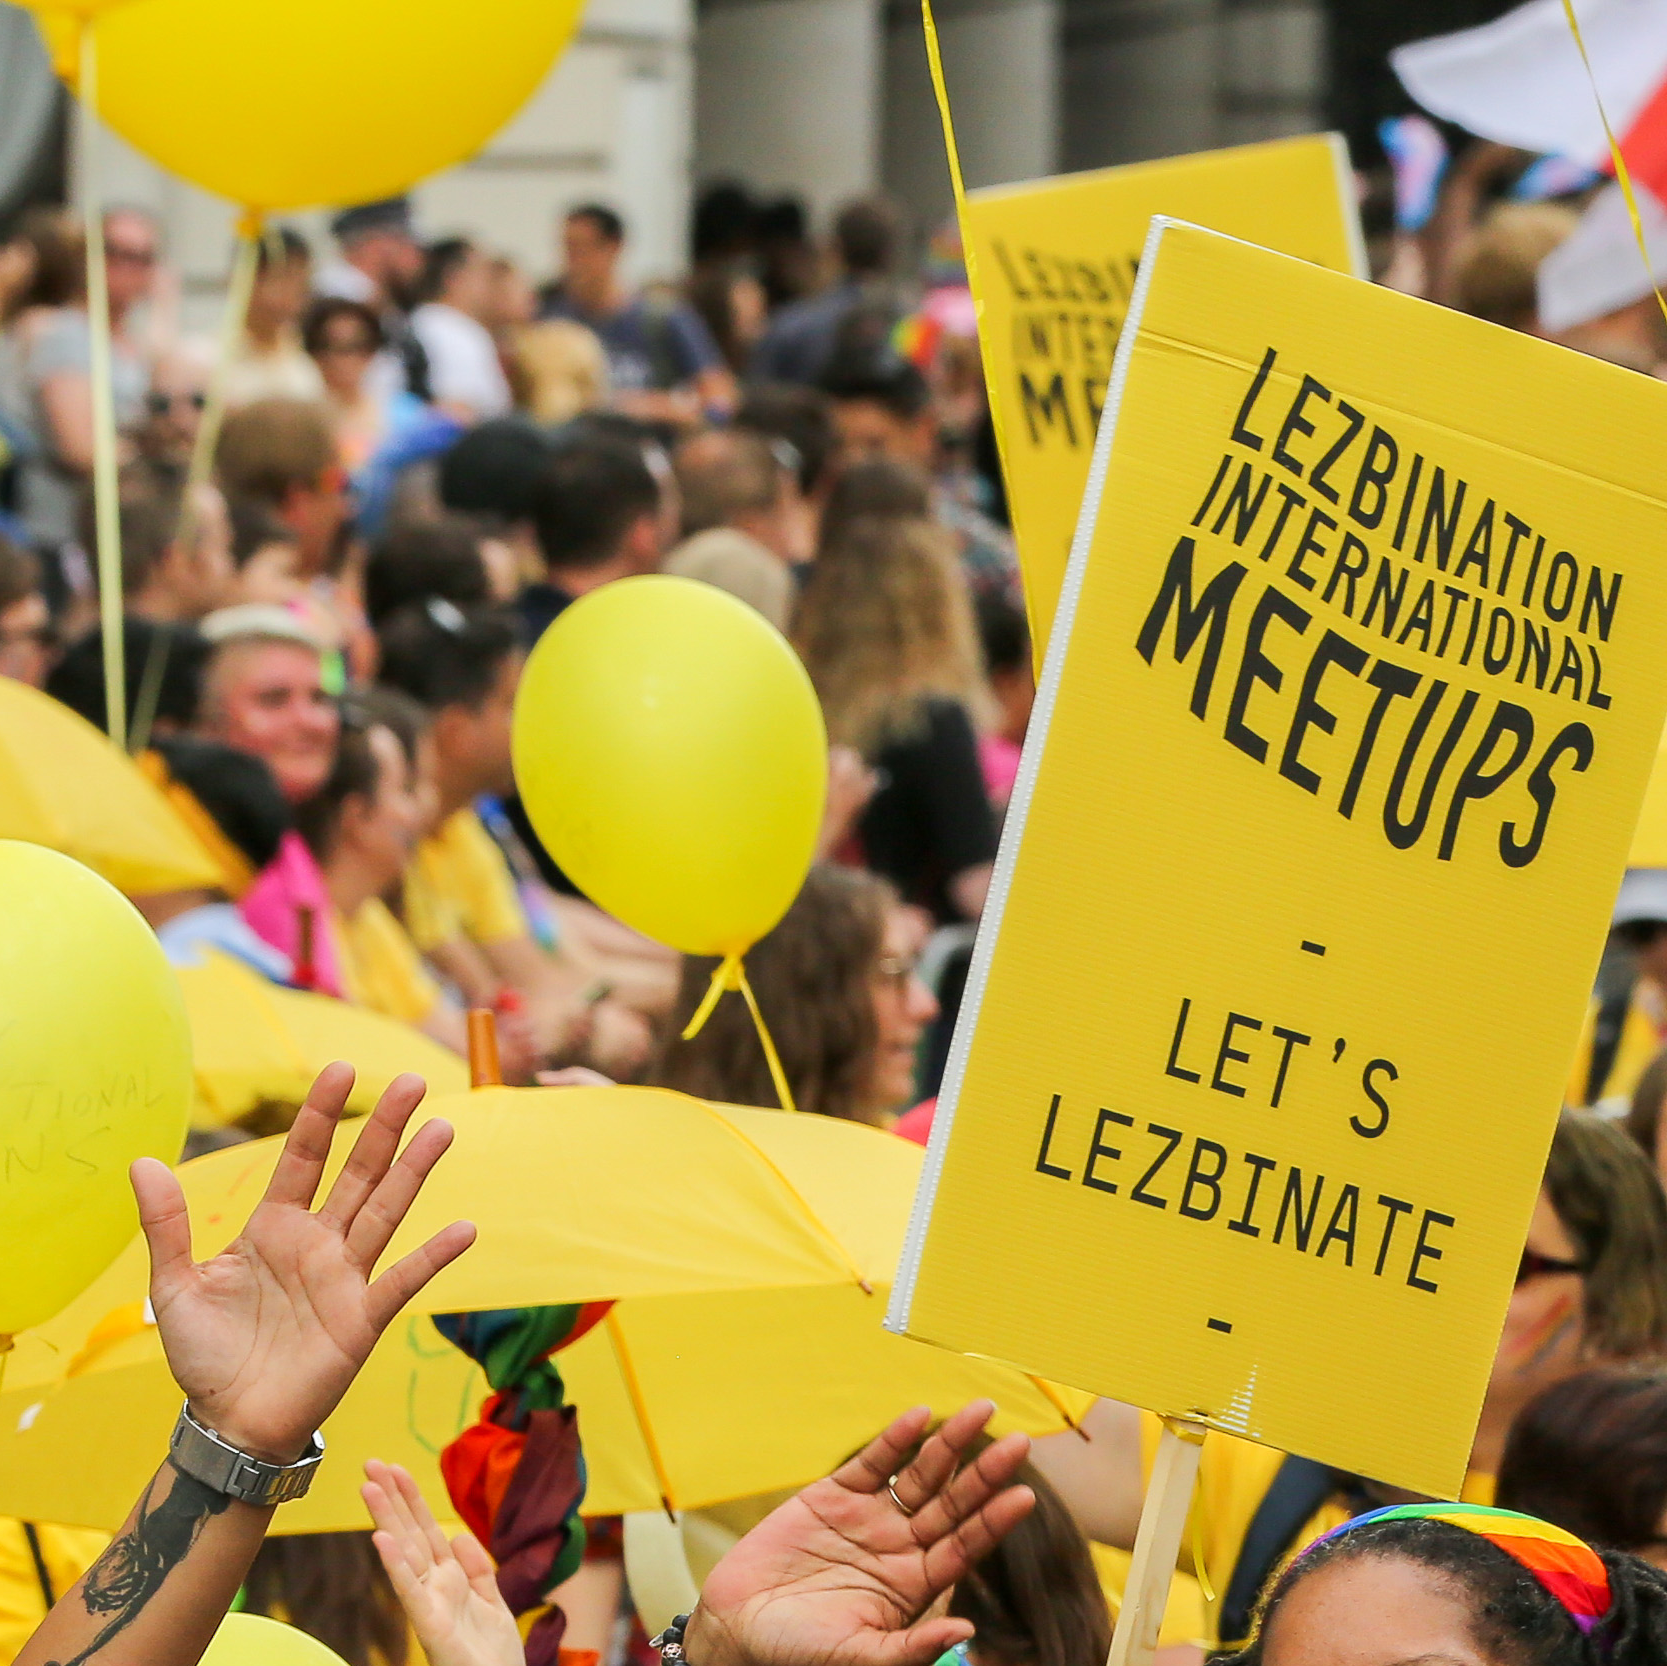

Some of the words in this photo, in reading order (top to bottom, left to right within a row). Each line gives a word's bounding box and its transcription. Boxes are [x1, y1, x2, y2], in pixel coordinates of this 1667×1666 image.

[1191, 454, 1612, 710] INTERNATIONAL
[1230, 347, 1622, 642] LEZBINATION
[1134, 536, 1594, 868] MEETUPS
[1034, 1093, 1455, 1294] LEZBINATE
[1164, 997, 1399, 1140] LET'S
